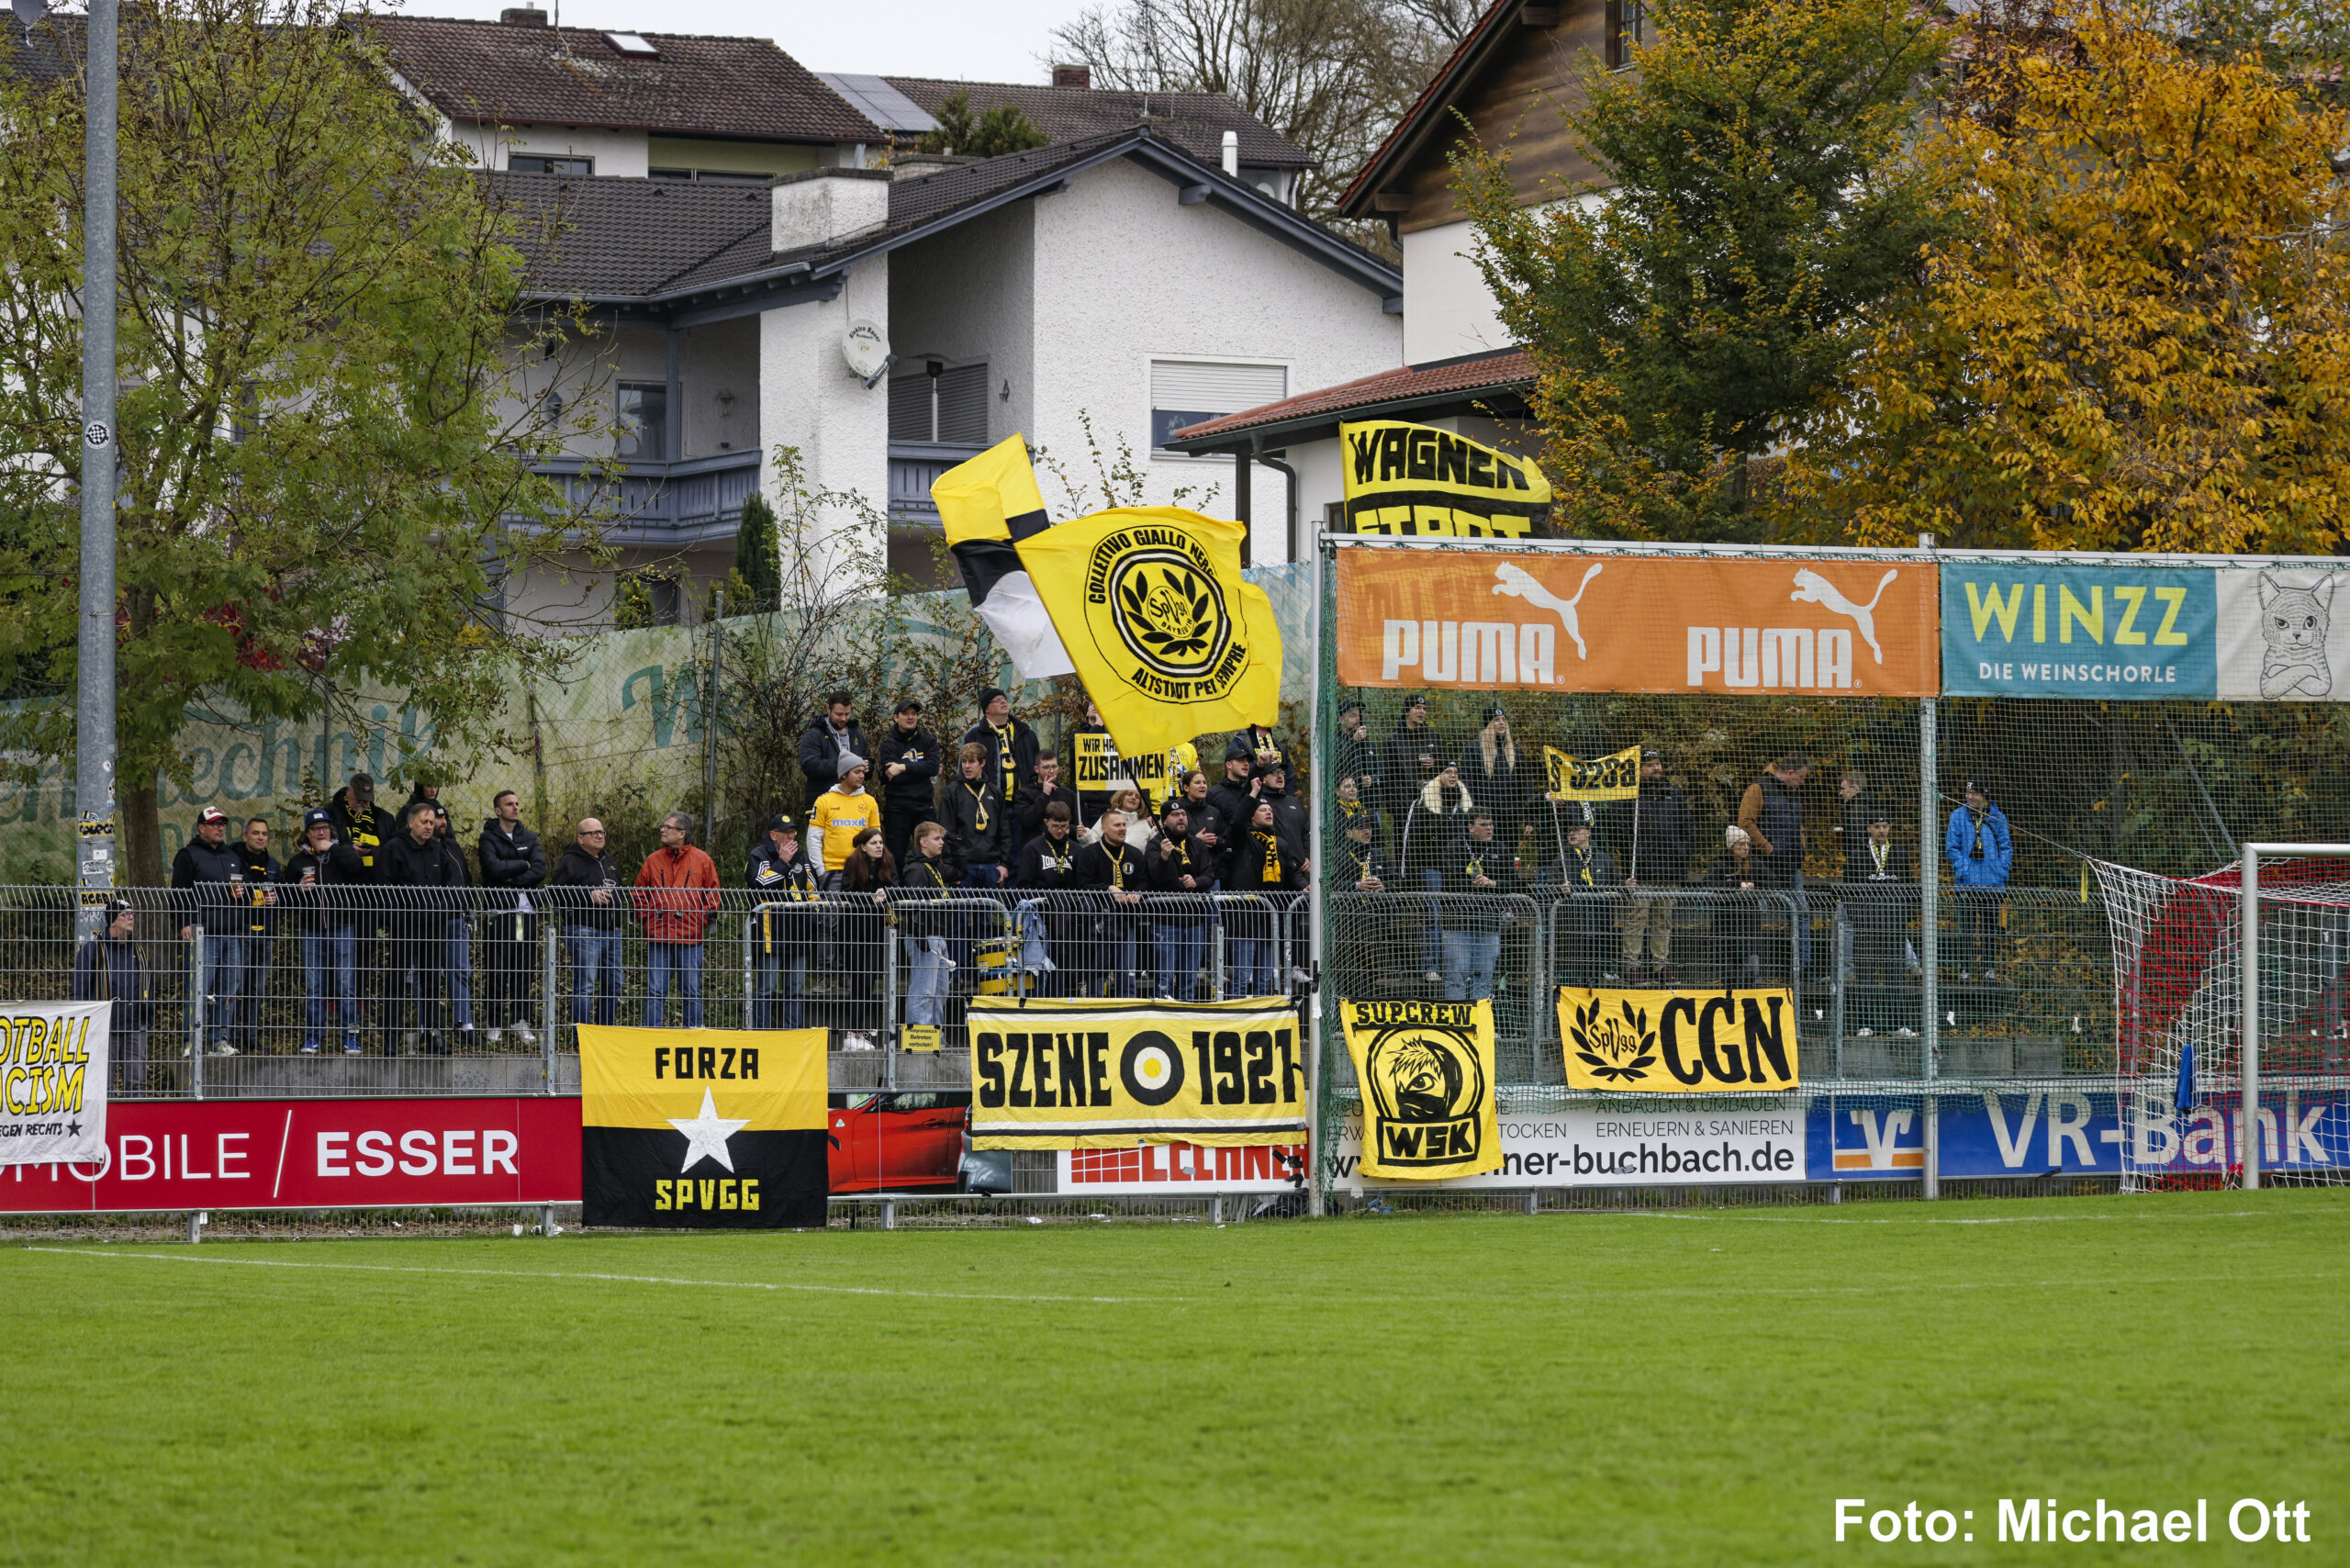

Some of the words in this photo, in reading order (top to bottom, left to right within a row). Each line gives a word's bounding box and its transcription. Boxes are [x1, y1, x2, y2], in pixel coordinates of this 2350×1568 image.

[1134, 529, 1186, 550] GIALLO
[1964, 581, 2188, 646] WINZZ
[1382, 619, 1556, 684] PUMA
[1687, 626, 1852, 689] PUMA
[1978, 662, 2013, 680] DIE
[2021, 662, 2177, 683] WEINSCHORLE
[1079, 753, 1165, 781] ZUSAMMEN
[832, 816, 867, 827] maxit
[1355, 1000, 1472, 1026] SUPCREW
[1660, 996, 1793, 1086] CGN
[655, 1047, 759, 1080] FORZA
[977, 1032, 1113, 1108] SZENE
[1192, 1027, 1298, 1105] 1921
[0, 1065, 86, 1116] CISM
[26, 1122, 63, 1136] RECHTS
[1385, 1124, 1474, 1159] WSK
[1498, 1123, 1567, 1138] TOCKEN
[1596, 1121, 1690, 1137] ERNEUERN
[1695, 1120, 1706, 1137] &
[1709, 1119, 1794, 1137] SANIEREN
[1983, 1090, 2331, 1168] VR-Bank
[317, 1129, 520, 1177] ESSER
[655, 1179, 760, 1211] SPVGG
